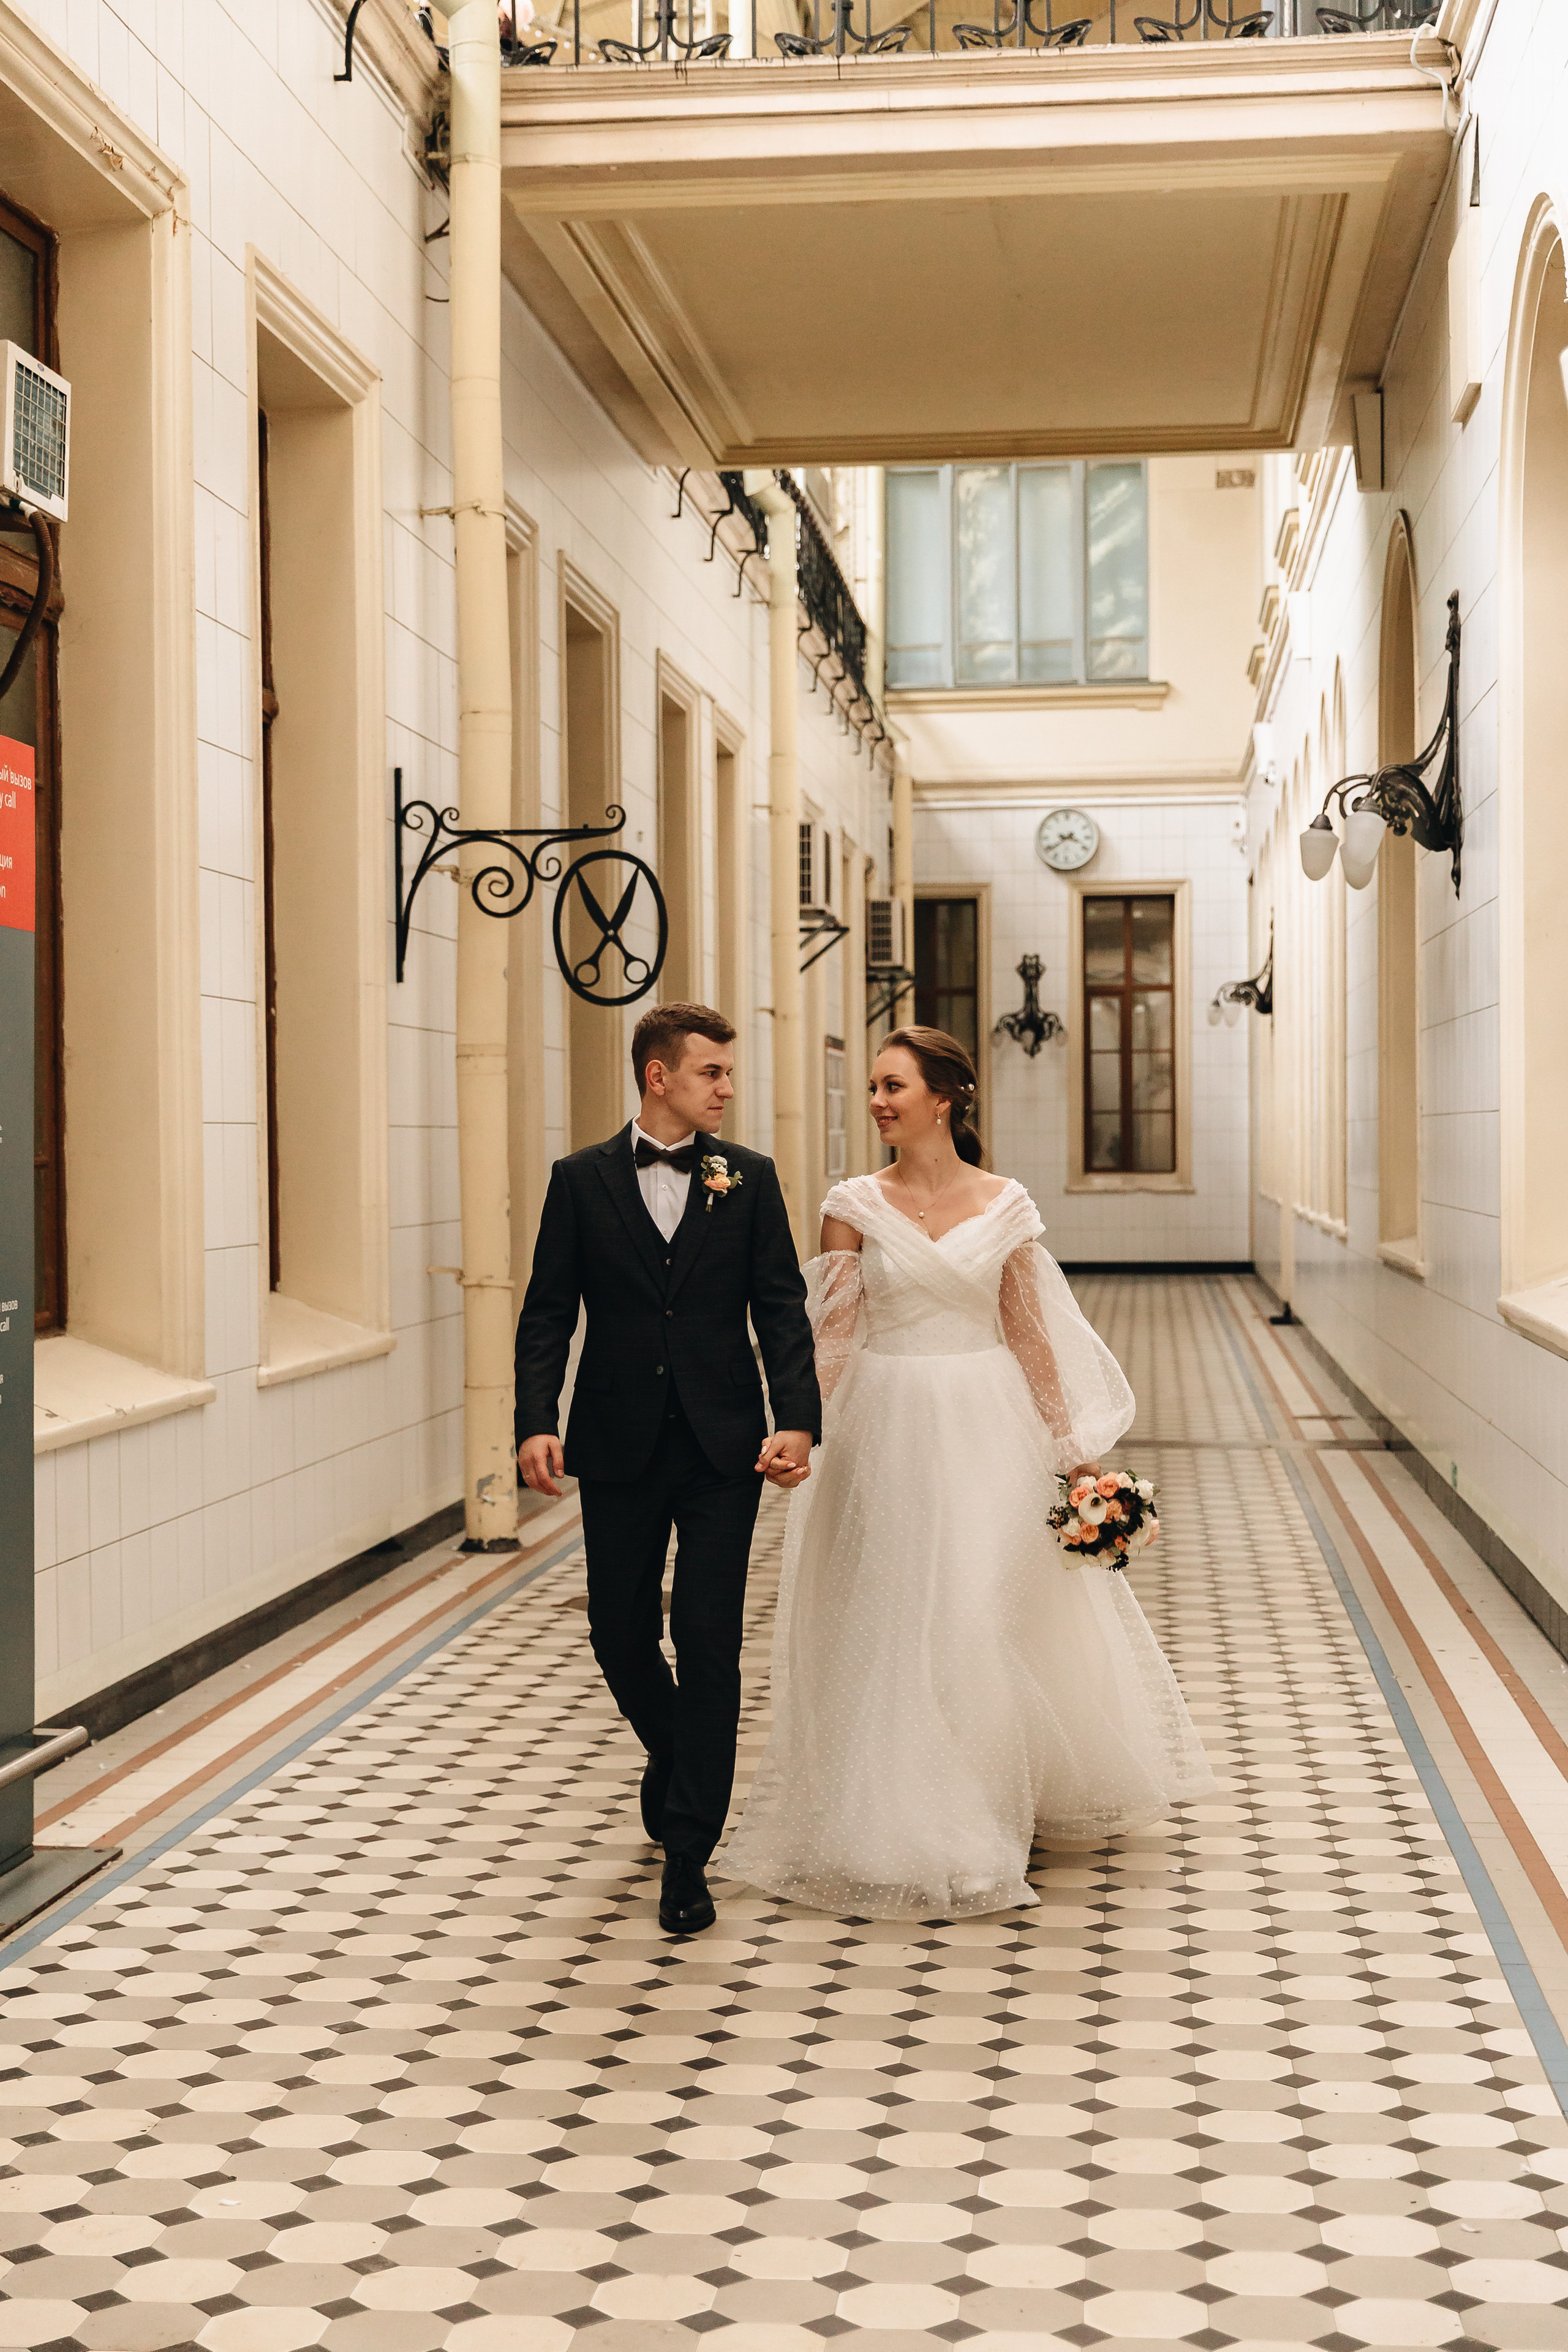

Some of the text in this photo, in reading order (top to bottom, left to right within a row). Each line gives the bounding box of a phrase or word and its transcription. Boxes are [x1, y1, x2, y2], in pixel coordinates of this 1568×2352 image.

[10, 771, 32, 790] вызов
[4, 790, 16, 809] call
[1, 1300, 18, 1312] вызов
